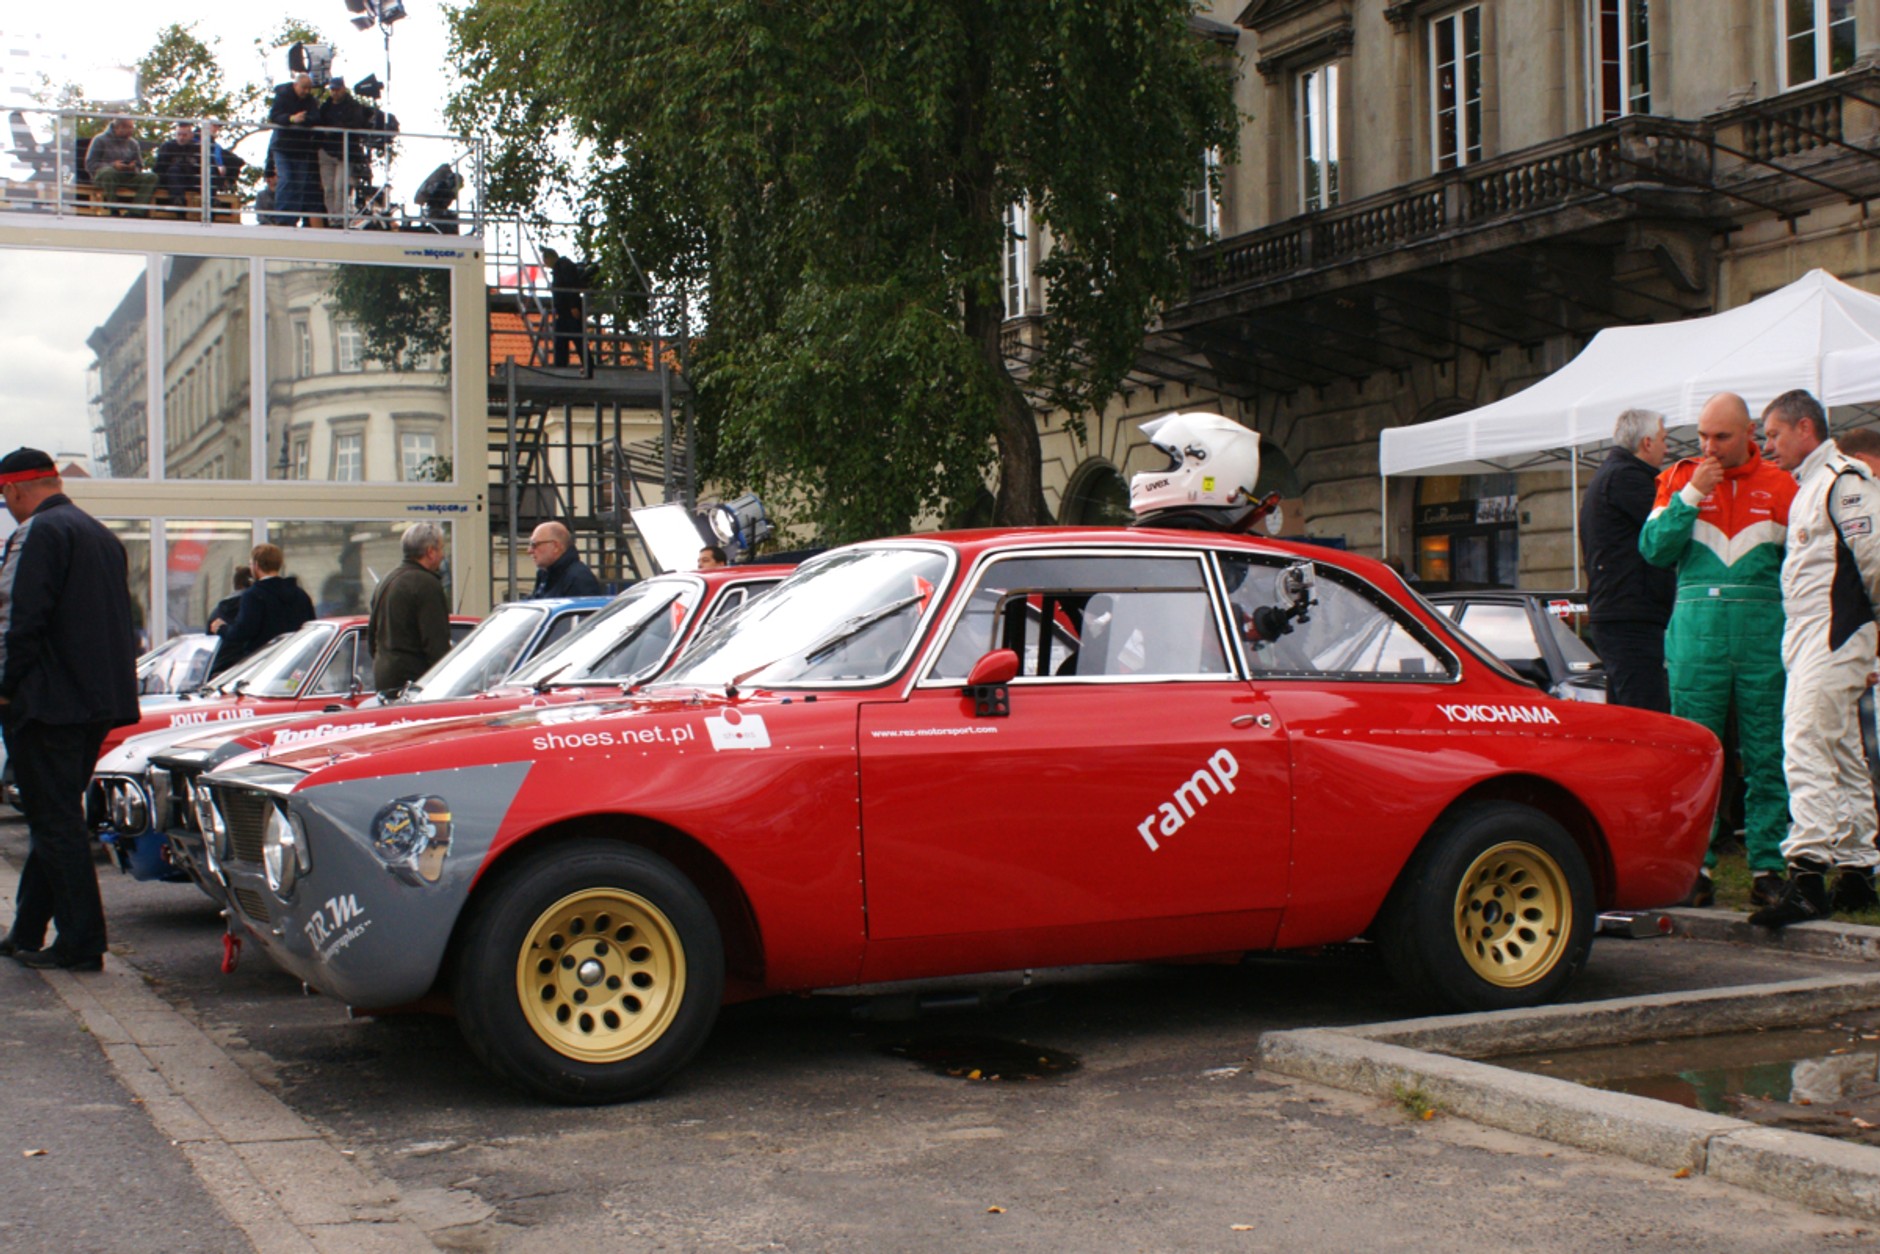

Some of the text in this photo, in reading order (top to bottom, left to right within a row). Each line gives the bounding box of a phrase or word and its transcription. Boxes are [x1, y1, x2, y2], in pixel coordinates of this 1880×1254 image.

[1145, 479, 1170, 492] uvex
[217, 708, 255, 721] CLUB
[1436, 704, 1561, 724] YOKOHAMA
[273, 722, 377, 746] TopGear
[532, 723, 695, 751] shoes.net.pl
[870, 726, 998, 738] www.rez-motorsport.com
[1136, 748, 1239, 852] ramp
